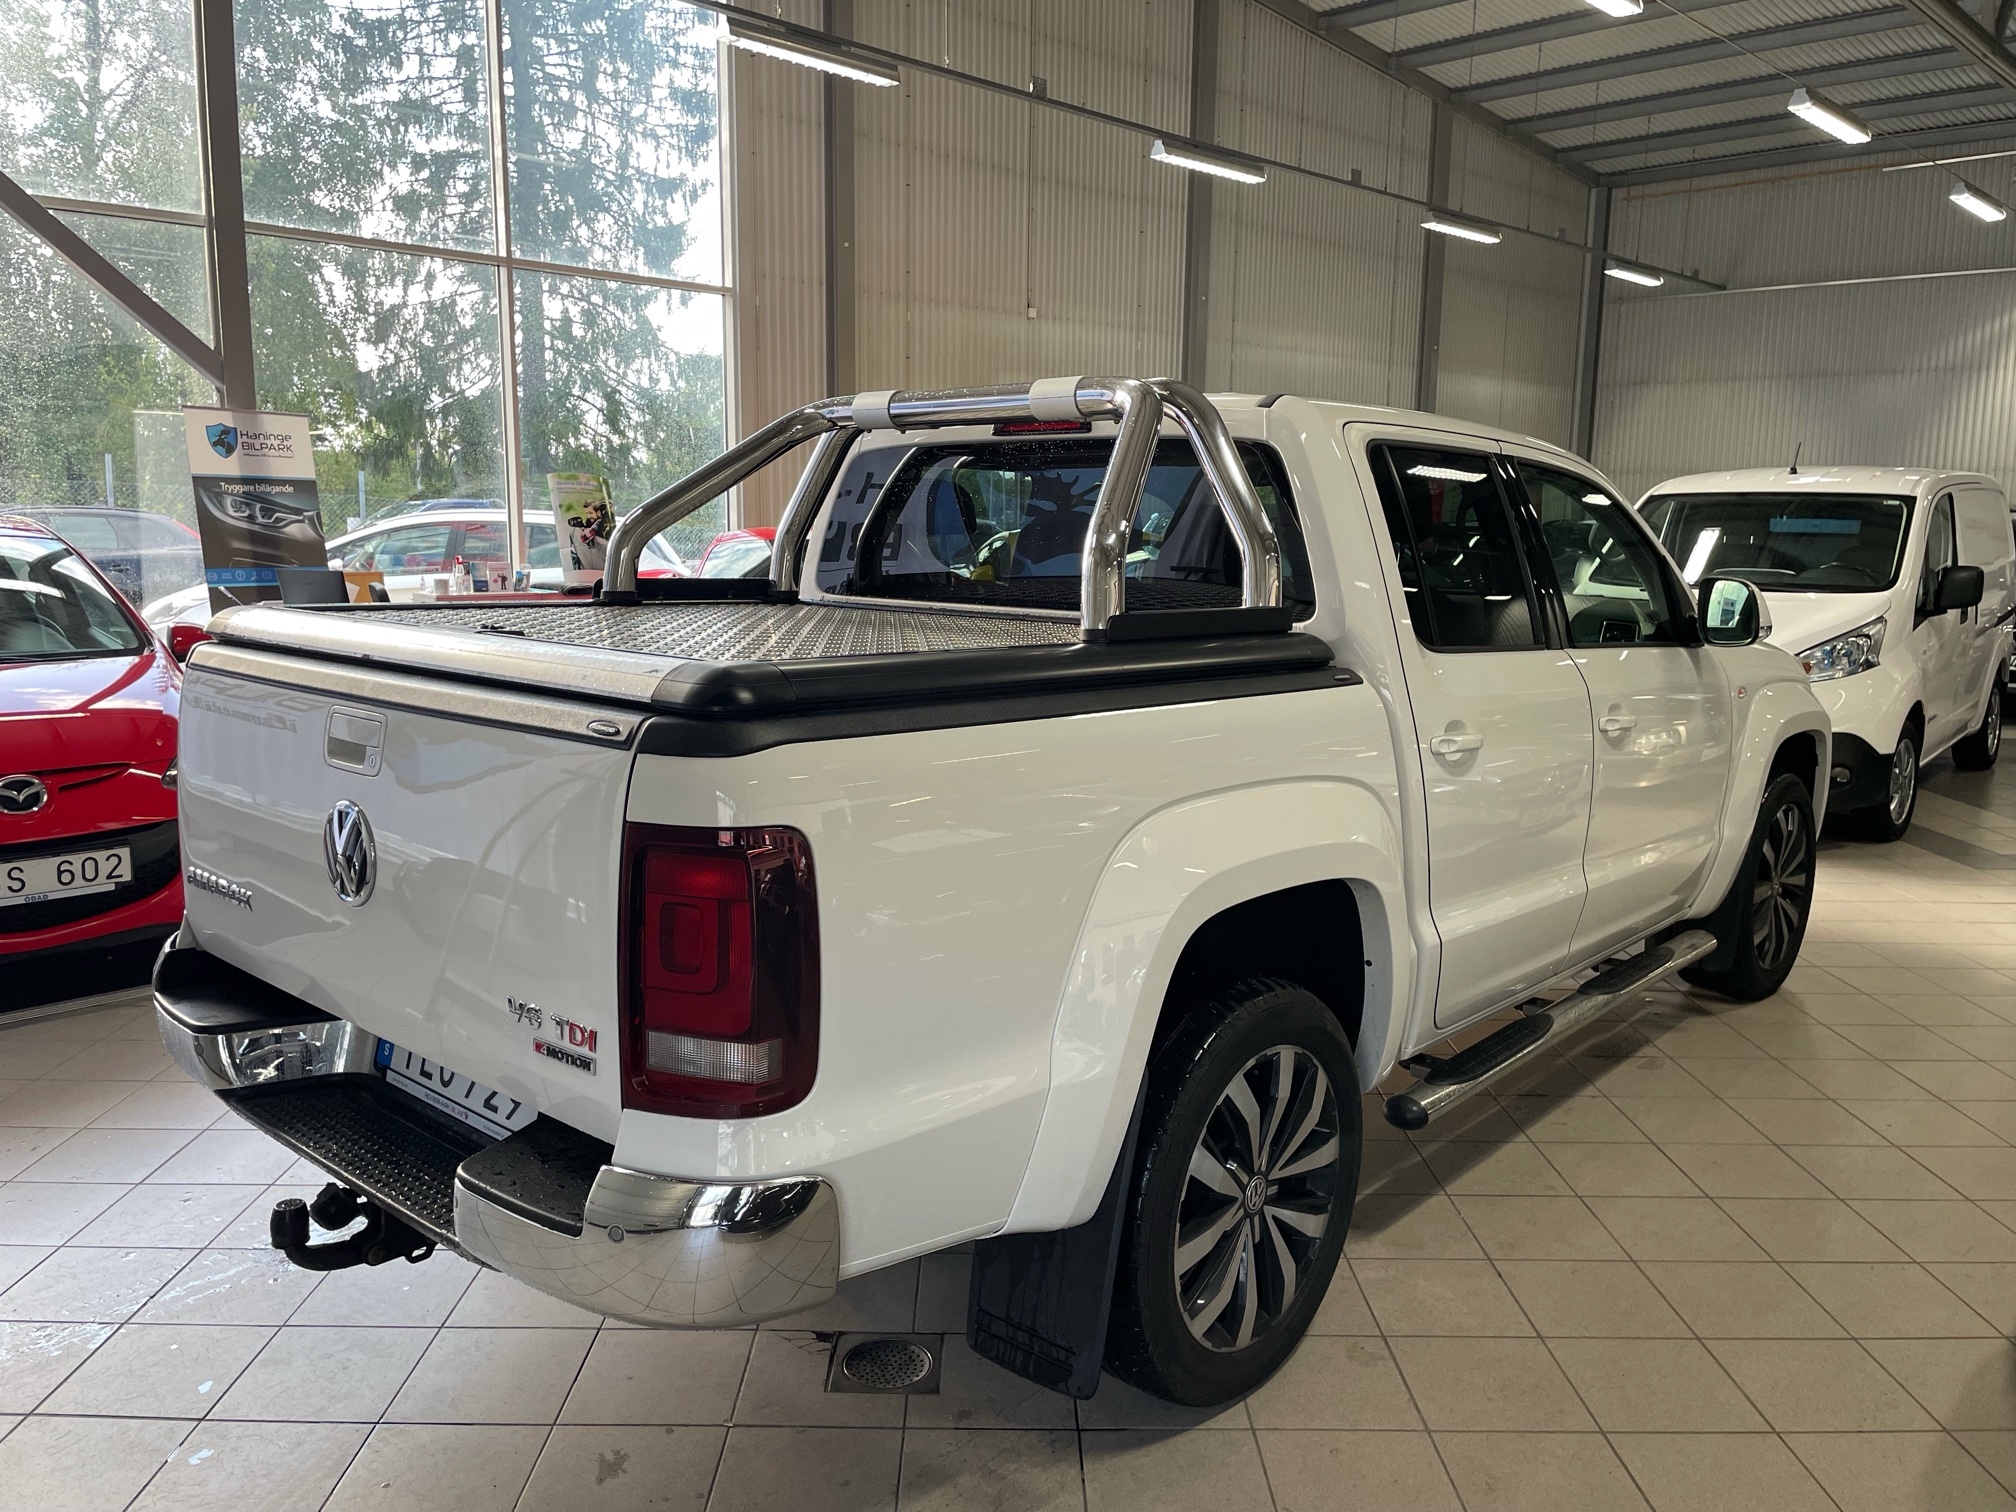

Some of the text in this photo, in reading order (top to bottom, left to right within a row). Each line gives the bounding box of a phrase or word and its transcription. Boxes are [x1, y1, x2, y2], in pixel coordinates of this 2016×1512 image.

[240, 430, 292, 443] Haninge
[241, 441, 294, 453] BILPARK
[220, 482, 294, 495] Tryggare bilägande
[7, 853, 124, 894] S 602
[507, 995, 597, 1054] V6 TDI
[539, 1043, 592, 1072] 4MOTION
